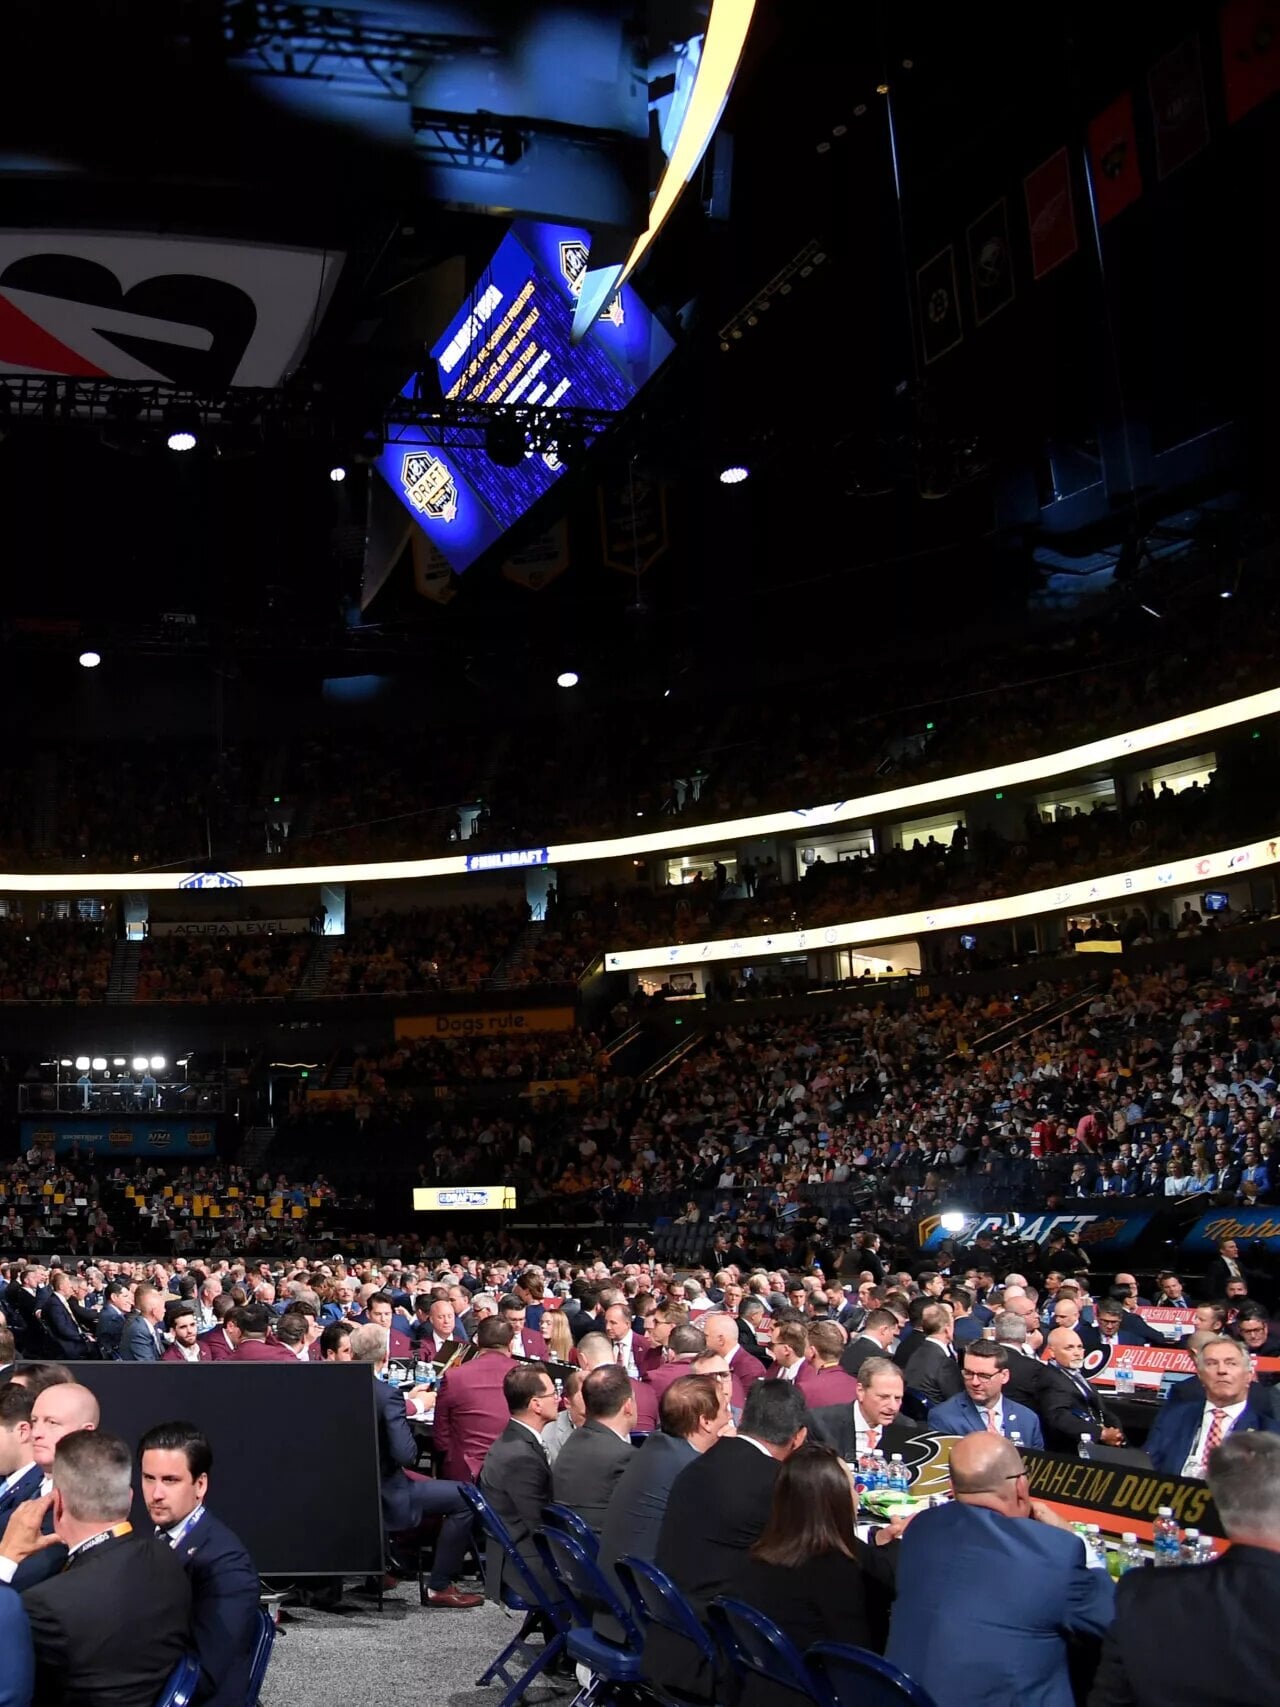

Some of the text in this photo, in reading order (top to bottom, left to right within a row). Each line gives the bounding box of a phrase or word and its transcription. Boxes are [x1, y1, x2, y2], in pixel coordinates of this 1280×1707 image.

[411, 465, 445, 503] DRAFT
[437, 1013, 528, 1035] Dogs rule.
[148, 1133, 172, 1142] NHL
[1139, 1308, 1190, 1322] WASHINGTON
[1113, 1474, 1211, 1522] DUCKS
[81, 1532, 110, 1552] AWARDS
